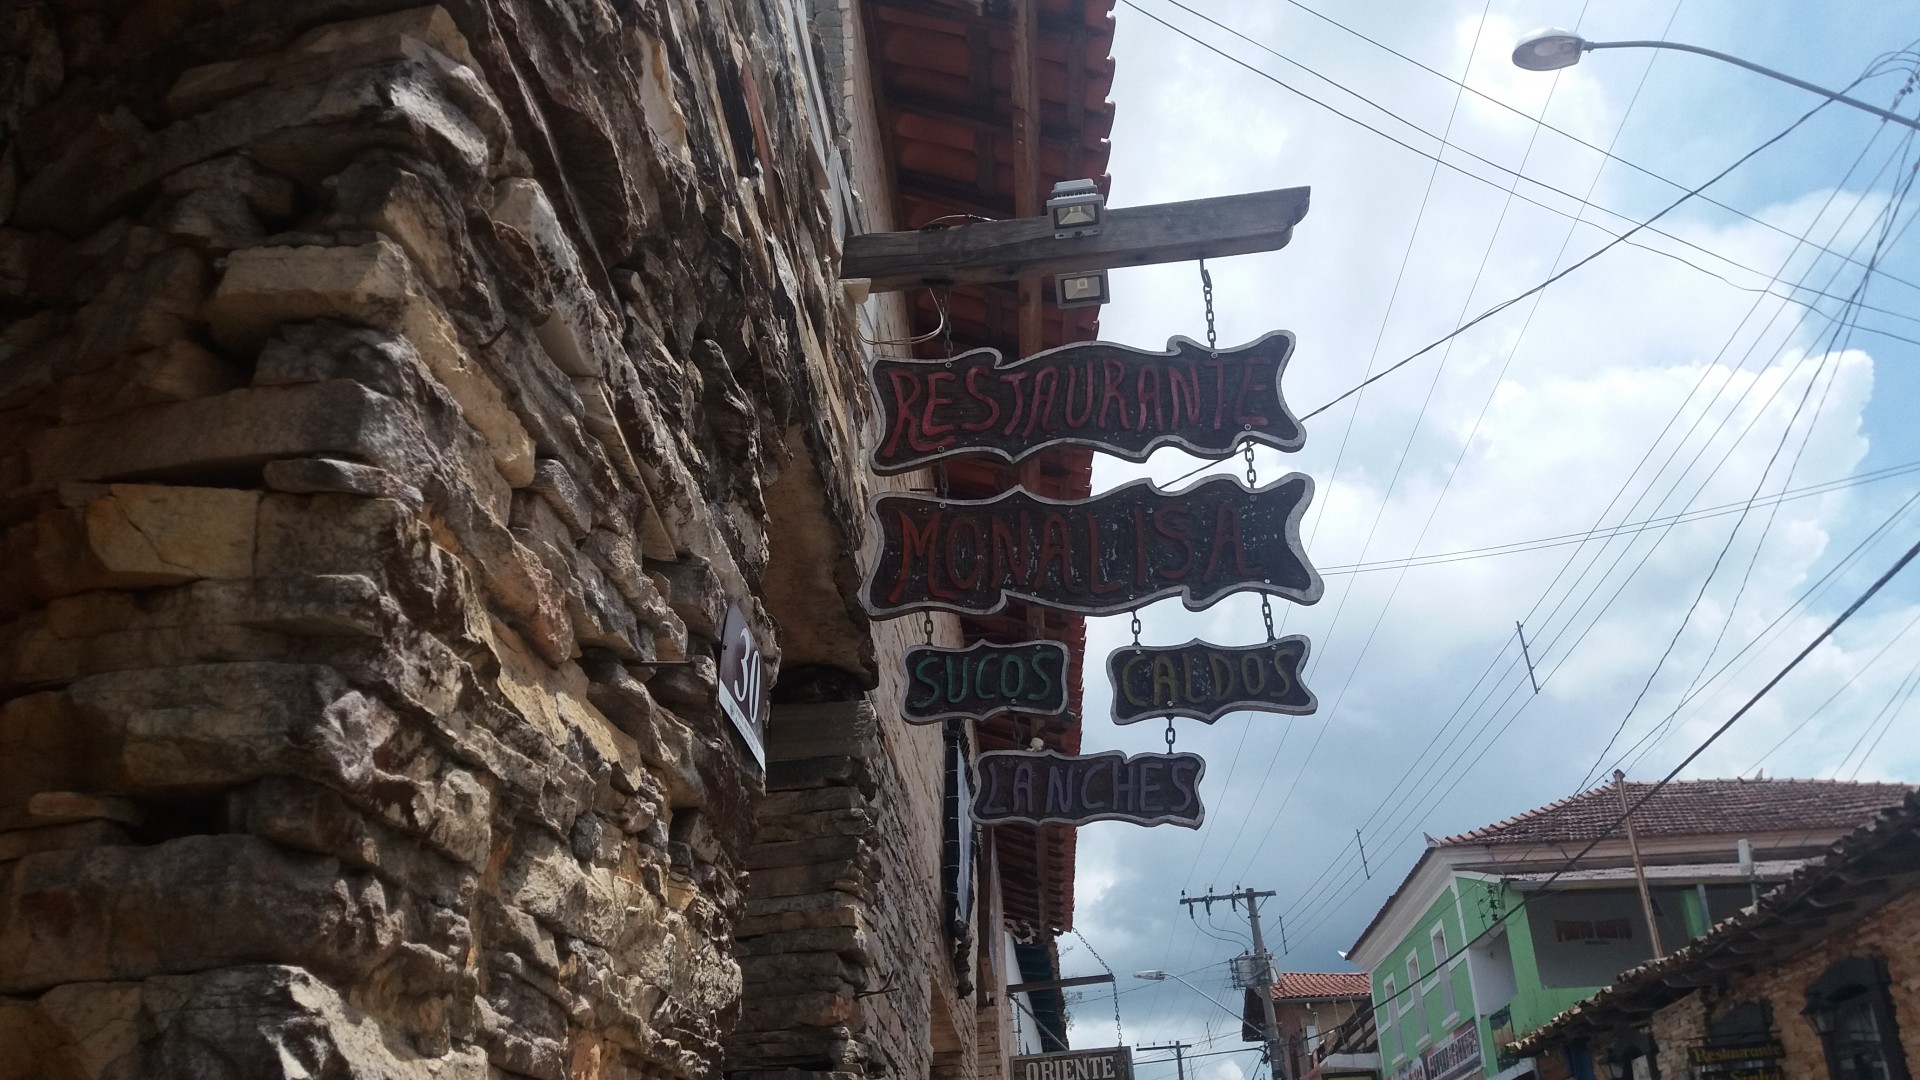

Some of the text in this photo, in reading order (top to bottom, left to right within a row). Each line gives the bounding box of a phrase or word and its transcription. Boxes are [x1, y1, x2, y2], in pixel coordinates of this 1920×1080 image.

[886, 359, 1269, 458] RESTAURANTE
[890, 505, 1265, 604] MONALISA
[735, 629, 760, 723] 30
[916, 652, 1057, 706] SUCOS
[1123, 648, 1298, 707] CALDOS
[985, 761, 1196, 815] LANCHES
[1027, 1056, 1115, 1080] ORIENTE
